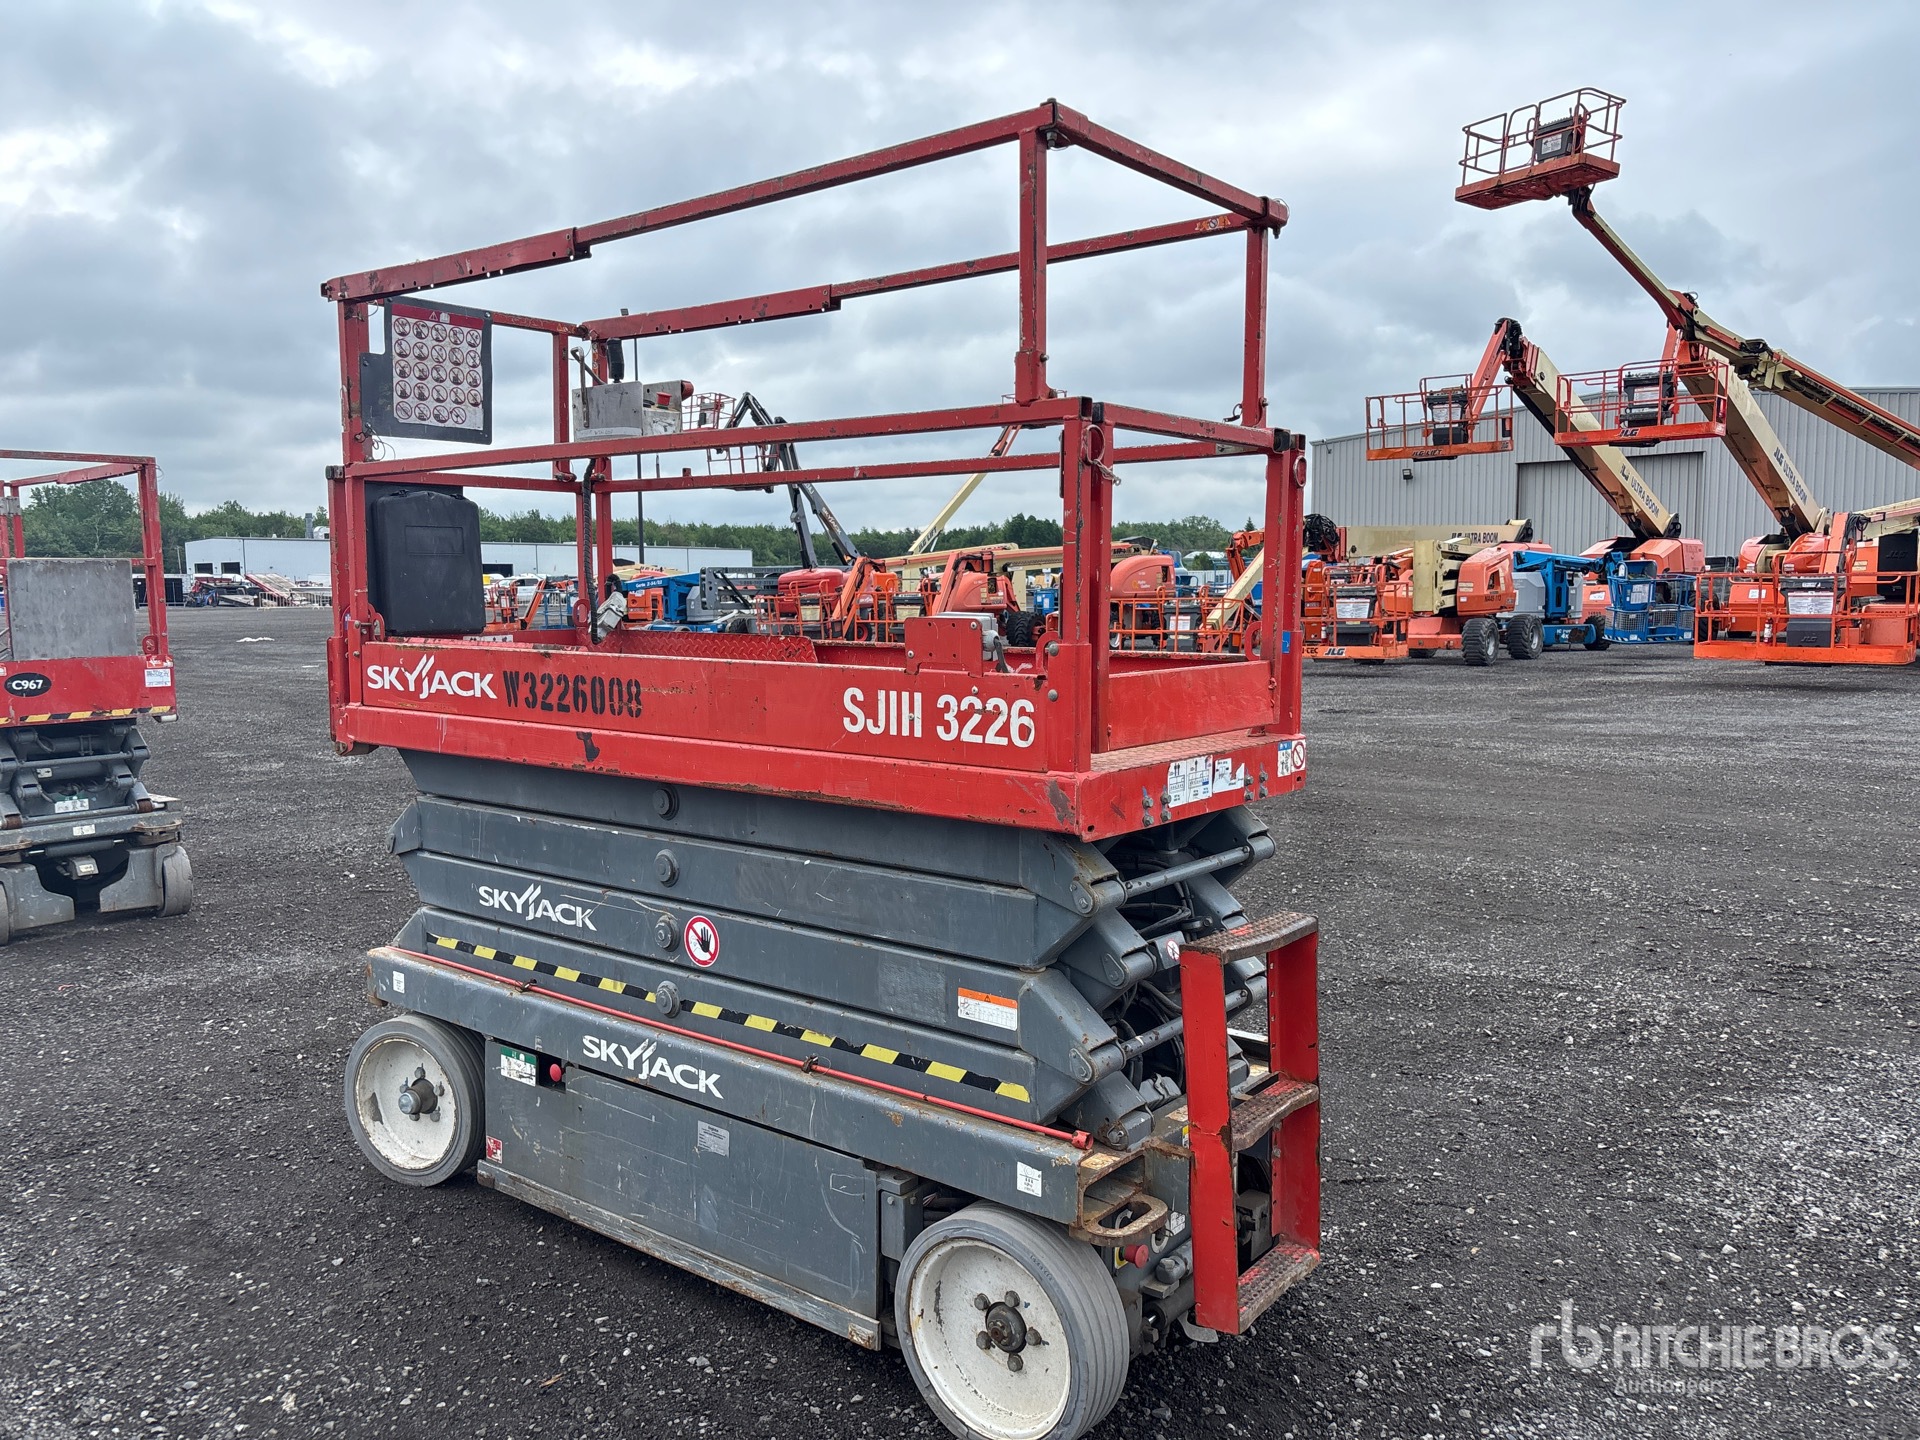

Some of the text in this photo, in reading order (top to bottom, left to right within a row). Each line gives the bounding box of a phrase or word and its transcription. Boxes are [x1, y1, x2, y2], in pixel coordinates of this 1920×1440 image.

[1620, 429, 1639, 437] JLG
[1482, 532, 1499, 544] BOOM
[1324, 648, 1345, 656] JLG
[12, 680, 44, 691] C967
[367, 654, 643, 719] SKYJACK W3226008
[936, 694, 1036, 748] 3226
[478, 883, 598, 931] SKYJACK
[582, 1035, 725, 1099] SKYJACK
